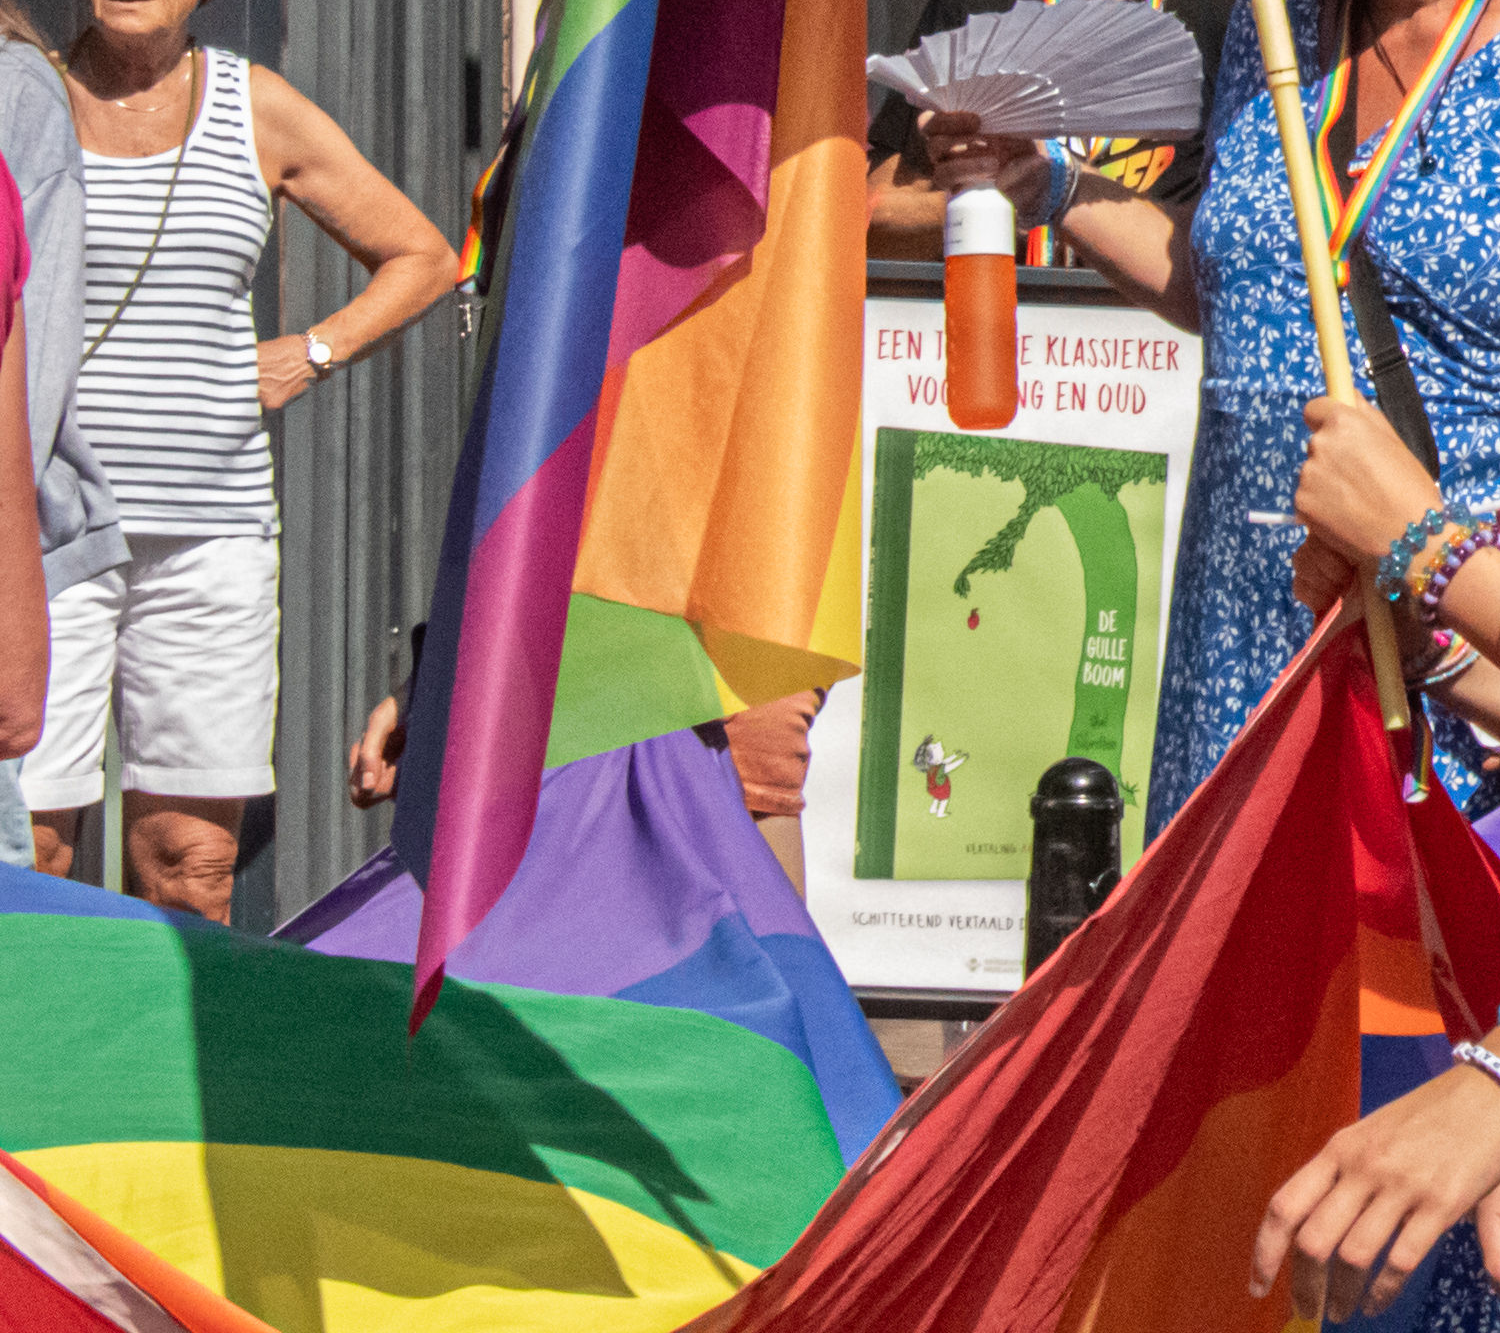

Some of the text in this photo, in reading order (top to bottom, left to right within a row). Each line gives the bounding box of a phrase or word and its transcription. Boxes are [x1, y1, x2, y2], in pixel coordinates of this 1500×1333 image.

[877, 328, 923, 360] EEN
[1045, 334, 1180, 371] KLASSIEKER
[1055, 380, 1087, 412] EN
[1097, 382, 1147, 415] OUD
[1097, 609, 1119, 633] DE
[1085, 635, 1129, 662] GULLE
[1081, 661, 1126, 690] BOOM
[851, 911, 943, 929] SCHITTEREND
[949, 915, 1015, 931] VERTAALD
